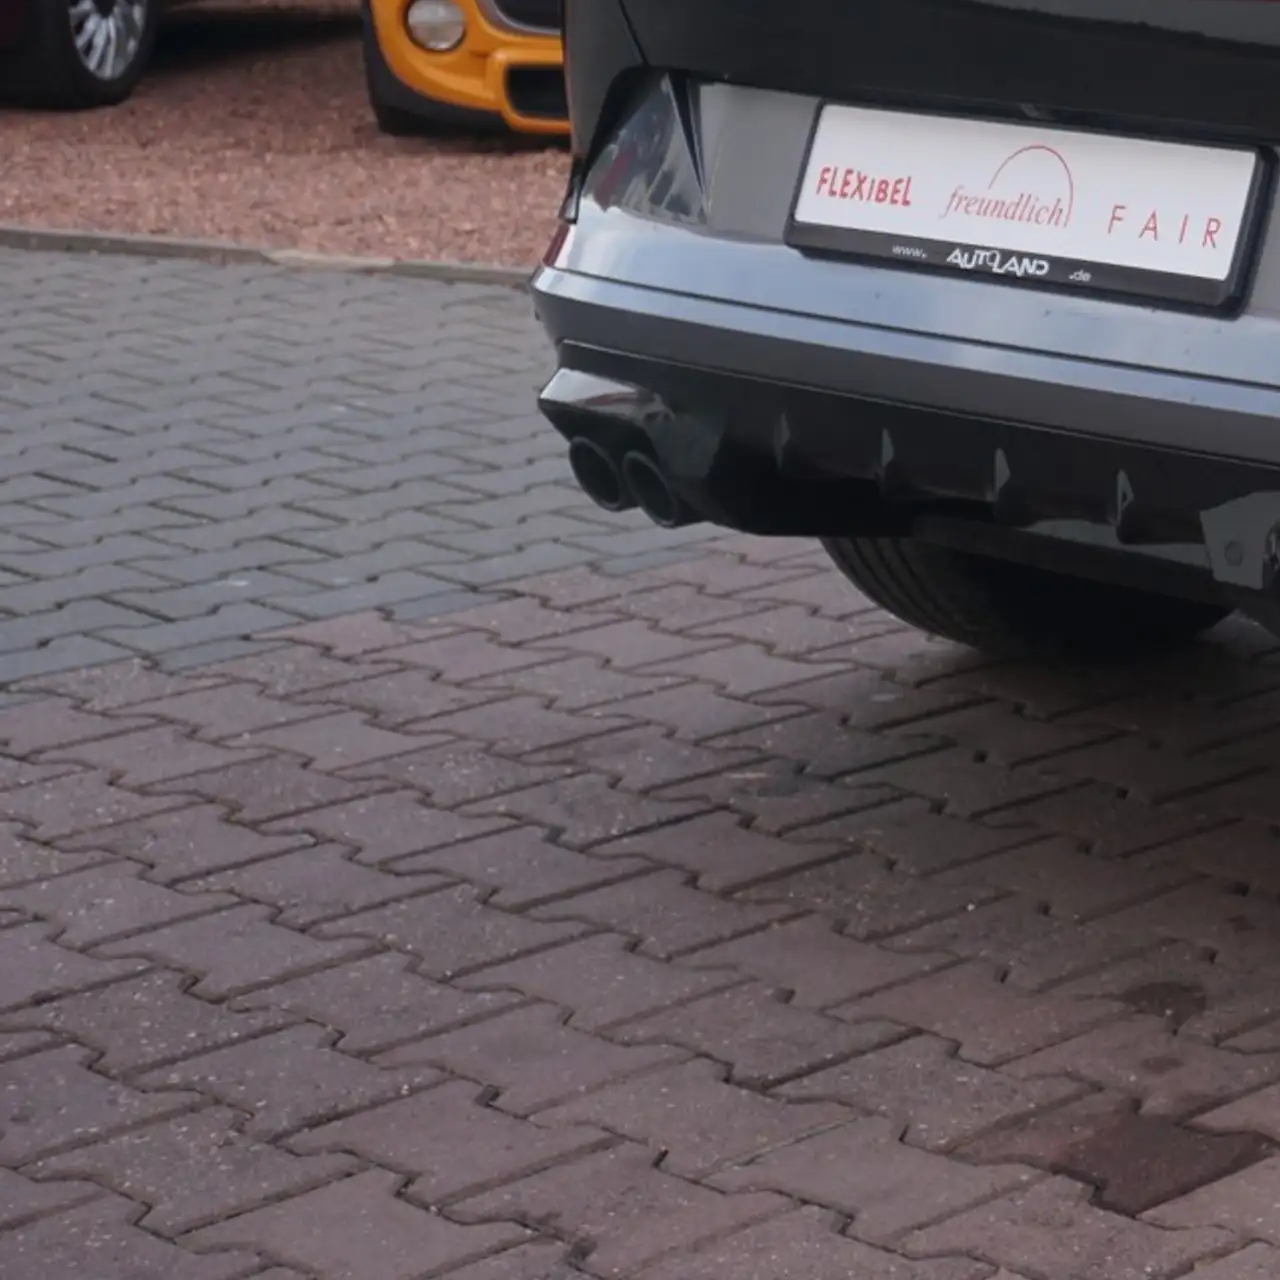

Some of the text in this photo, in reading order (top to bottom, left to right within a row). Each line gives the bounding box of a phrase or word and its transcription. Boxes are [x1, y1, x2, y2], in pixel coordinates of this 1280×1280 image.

[816, 166, 1222, 249] FLEXIBEL freundlich FAIR
[946, 248, 1050, 277] AUTOLAND
